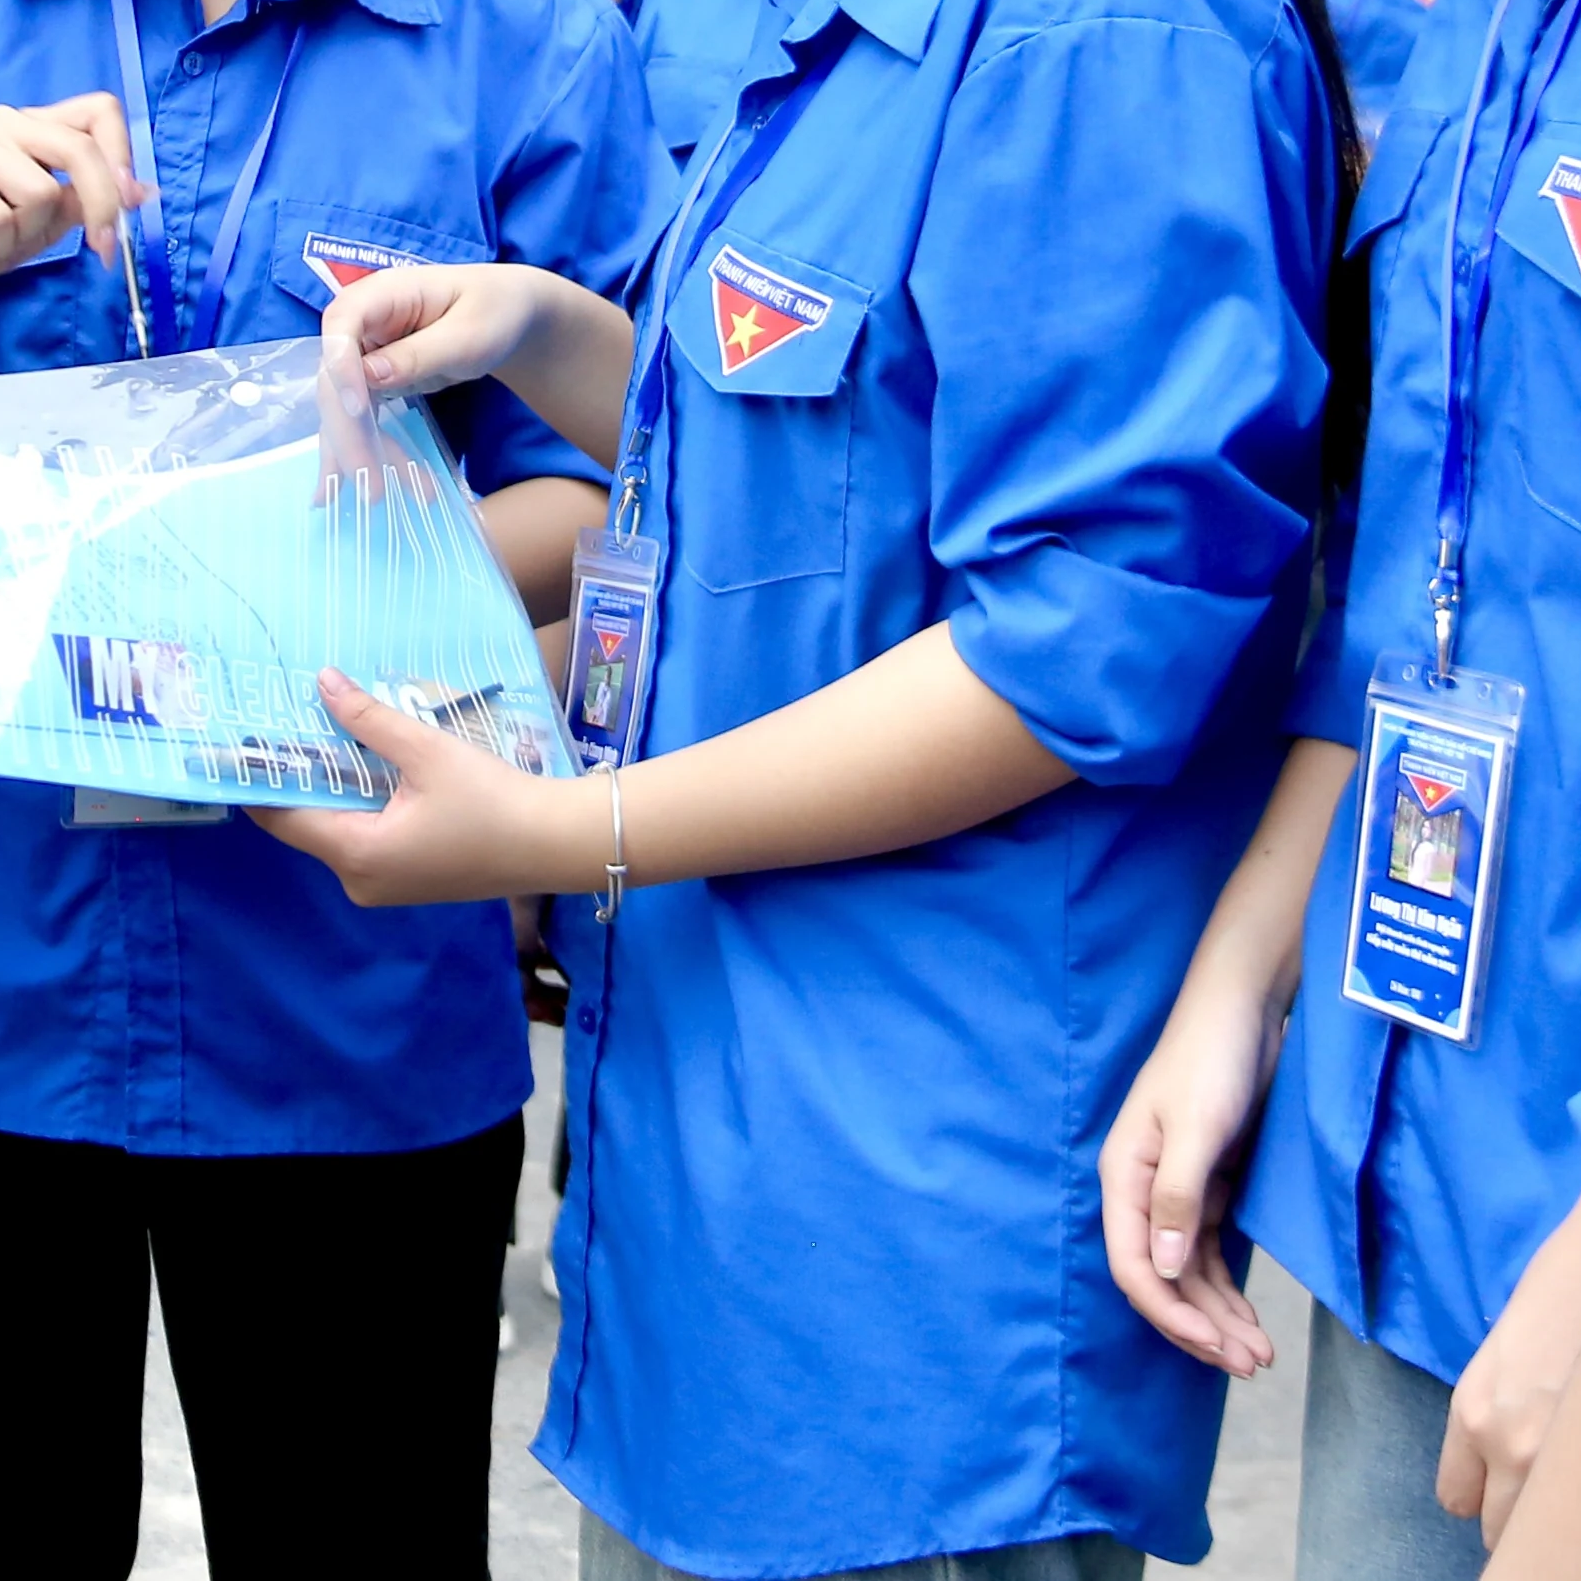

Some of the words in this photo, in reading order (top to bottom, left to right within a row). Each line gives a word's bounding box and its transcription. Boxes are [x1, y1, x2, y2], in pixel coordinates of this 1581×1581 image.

[311, 240, 356, 259] THANH
[358, 248, 389, 265] NIÊN
[793, 298, 824, 323] NAM
[89, 637, 158, 715] MY
[176, 651, 336, 737] CLEAR
